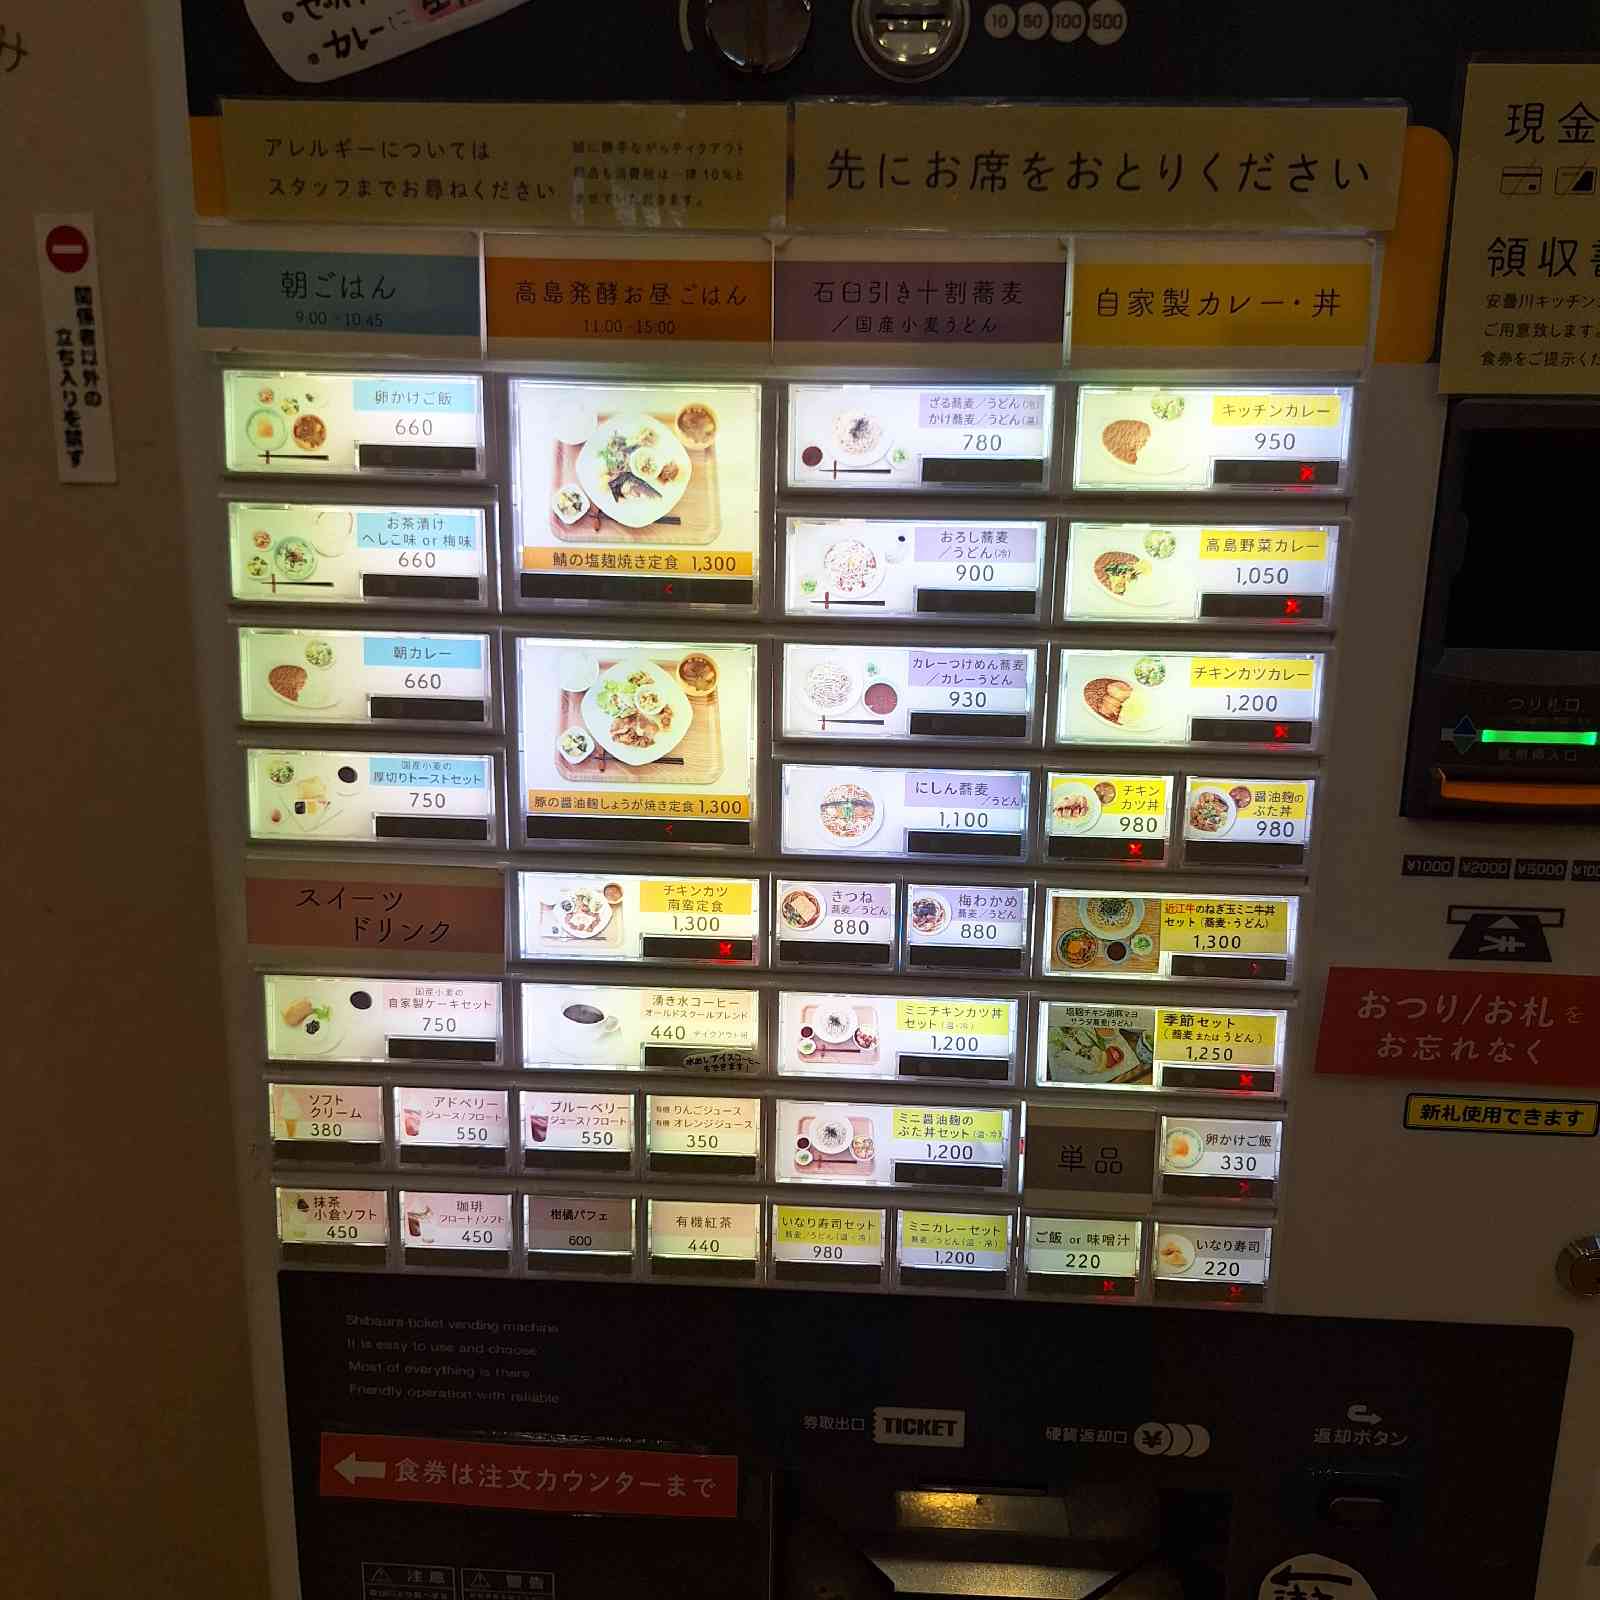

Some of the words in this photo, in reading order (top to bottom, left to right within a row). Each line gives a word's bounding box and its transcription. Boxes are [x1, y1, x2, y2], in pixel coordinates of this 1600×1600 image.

[992, 14, 1008, 29] 10
[1024, 14, 1042, 29] 50
[1057, 14, 1081, 29] 100
[1093, 14, 1122, 30] 500
[1503, 101, 1600, 145] 現金
[263, 137, 490, 161] アレルギーについては
[827, 150, 1370, 193] 先にお席をおとりください
[268, 178, 556, 201] スタッフまでお尋ねください
[1487, 236, 1600, 278] 領収
[280, 271, 396, 300] 朝ごはん
[516, 280, 748, 306] 高島発酵お昼ごはん
[814, 280, 1024, 305] 石臼引き十割蕎麦
[1096, 287, 1342, 319] 自家製カレー・丼
[1484, 322, 1600, 339] ご用意致します
[375, 390, 452, 407] 卵かけご飯
[1222, 404, 1331, 418] キッチンカレー
[395, 419, 434, 437] 660
[962, 434, 1002, 451] 780
[1254, 433, 1296, 451] 950
[387, 517, 445, 532] お茶漬け
[422, 536, 437, 548] or
[940, 530, 1009, 544] おろし蕎麦
[1206, 538, 1321, 553] 高島野菜カレー
[398, 552, 437, 570] 660
[691, 555, 738, 573] 1,300
[956, 564, 994, 582] 900
[1235, 566, 1289, 585] 1,050
[392, 645, 453, 661] 朝カレー
[912, 658, 1025, 672] カレーつけめん蕎麦
[1193, 665, 1311, 681] チキンカツカレー
[404, 673, 443, 690] 660
[949, 691, 987, 708] 930
[1225, 694, 1278, 713] 1,200
[1120, 785, 1160, 797] チキン
[408, 792, 447, 809] 750
[699, 799, 743, 815] 1,300
[1121, 800, 1158, 811] カツ丼
[1253, 805, 1292, 817] ぶた丼
[939, 811, 988, 828] 1,100
[1120, 817, 1157, 833] 980
[1257, 822, 1295, 838] 980
[664, 884, 728, 897] チキンカツ
[832, 891, 873, 904] きつね
[296, 886, 402, 912] スイーツ
[667, 899, 724, 913] 南蛮定食
[960, 893, 1018, 908] 梅わかめ
[1165, 903, 1276, 916] 近江牛のねぎ玉ミニ牛丼
[352, 916, 450, 944] ドリンク
[673, 915, 721, 932] 1,300
[833, 919, 870, 936] 880
[961, 924, 998, 940] 880
[1194, 934, 1241, 950] 1,300
[903, 1005, 1003, 1019] ミニチキンカツ丼
[422, 1017, 457, 1032] 750
[1163, 1015, 1236, 1029] 季節セット
[650, 1025, 686, 1040] 440
[930, 1036, 979, 1052] 1,200
[1376, 1033, 1542, 1065] お忘れなく
[1185, 1046, 1234, 1062] 1,250
[309, 1094, 344, 1106] ソフト
[432, 1096, 499, 1108] アドベリー
[550, 1102, 631, 1114] ブルーベリー
[310, 1108, 362, 1119] クリーム
[674, 1105, 742, 1116] りんごジュース
[1419, 1104, 1586, 1128] 新札使用できます
[310, 1123, 343, 1137] 380
[672, 1119, 753, 1129] オレンジジュース
[456, 1127, 488, 1141] 550
[581, 1131, 614, 1146] 550
[686, 1134, 718, 1149] 350
[1206, 1134, 1272, 1148] 卵かけご飯
[926, 1144, 974, 1160] 1,200
[1057, 1145, 1122, 1174] 単品
[1220, 1155, 1257, 1171] 330
[313, 1195, 341, 1208] 抹茶
[455, 1199, 483, 1213] 珈琲
[675, 1216, 733, 1229] 有機紅茶
[782, 1217, 876, 1230] いなり寿司セット
[908, 1221, 1001, 1235] ミニカレーセット
[326, 1225, 359, 1239] 450
[461, 1230, 494, 1244] 450
[1036, 1231, 1063, 1244] ご飯
[1069, 1236, 1081, 1245] or
[1087, 1232, 1131, 1247] 味噌汁
[568, 1234, 593, 1247] 600
[688, 1239, 720, 1253] 440
[1196, 1239, 1261, 1253] いなり寿司
[813, 1246, 843, 1260] 980
[936, 1250, 976, 1265] 1,200
[1065, 1253, 1101, 1269] 220
[1204, 1261, 1240, 1277] 220
[882, 1415, 957, 1437] TICKET
[395, 1456, 717, 1499] 食券は注文カウンターまで
